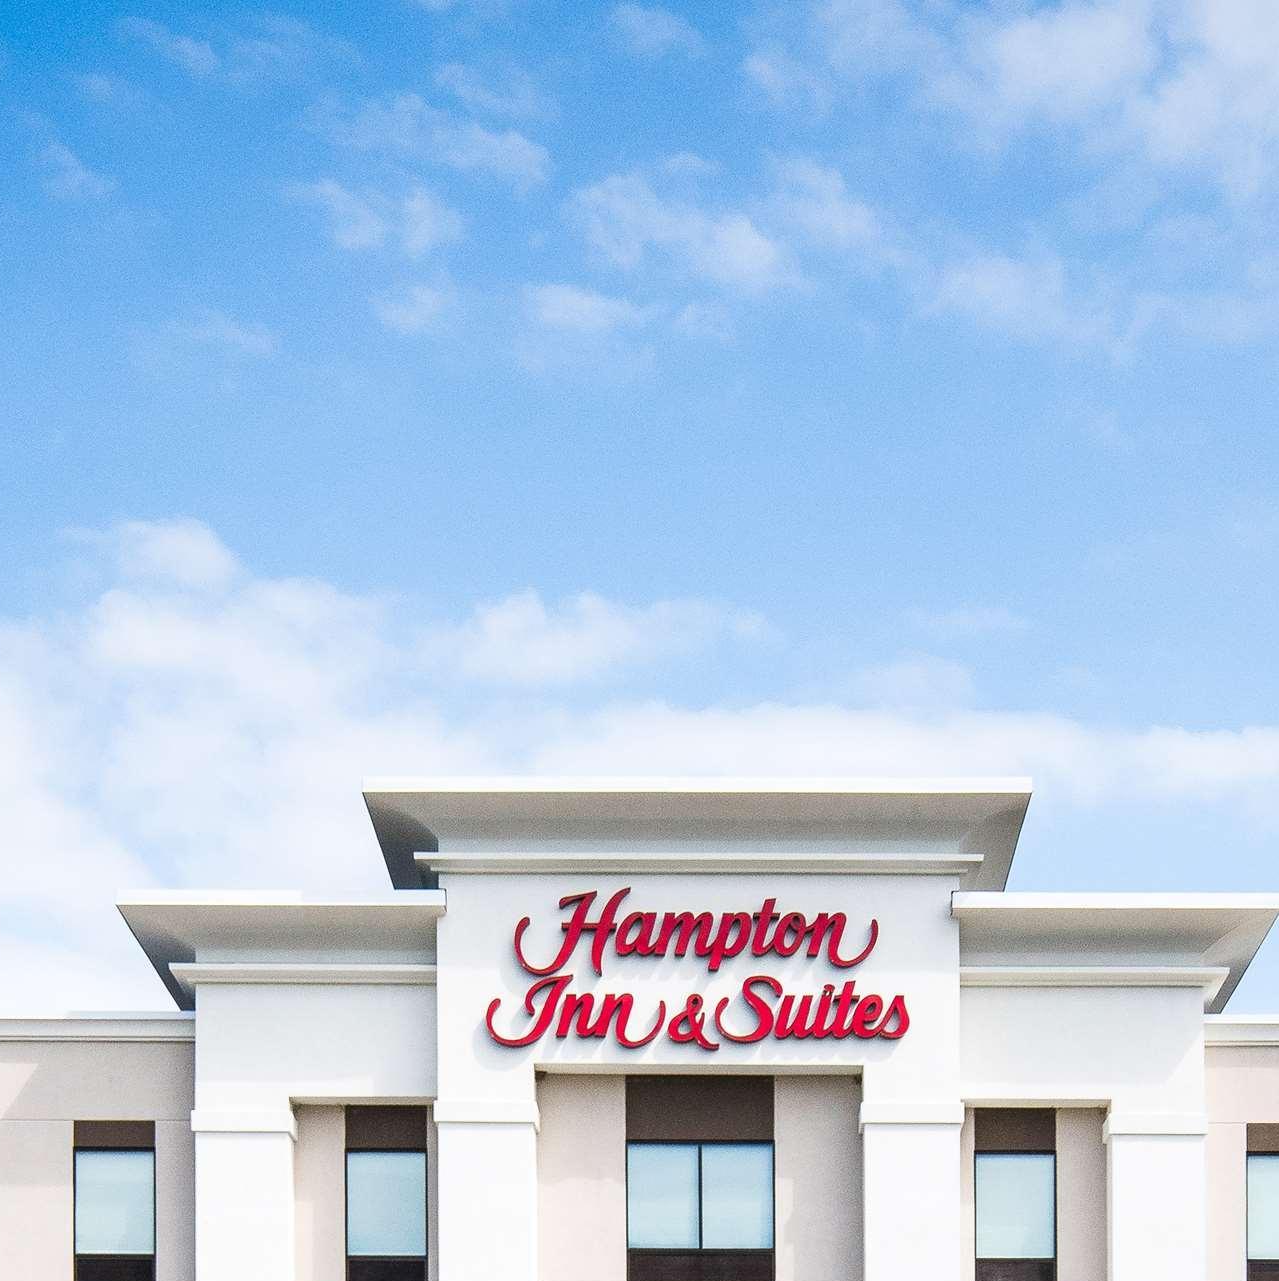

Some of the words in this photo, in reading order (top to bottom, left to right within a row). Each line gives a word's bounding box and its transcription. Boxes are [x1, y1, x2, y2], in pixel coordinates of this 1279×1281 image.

[514, 887, 879, 976] Hampton
[486, 974, 666, 1049] Inn
[666, 993, 720, 1051] &
[714, 975, 911, 1044] Suites
